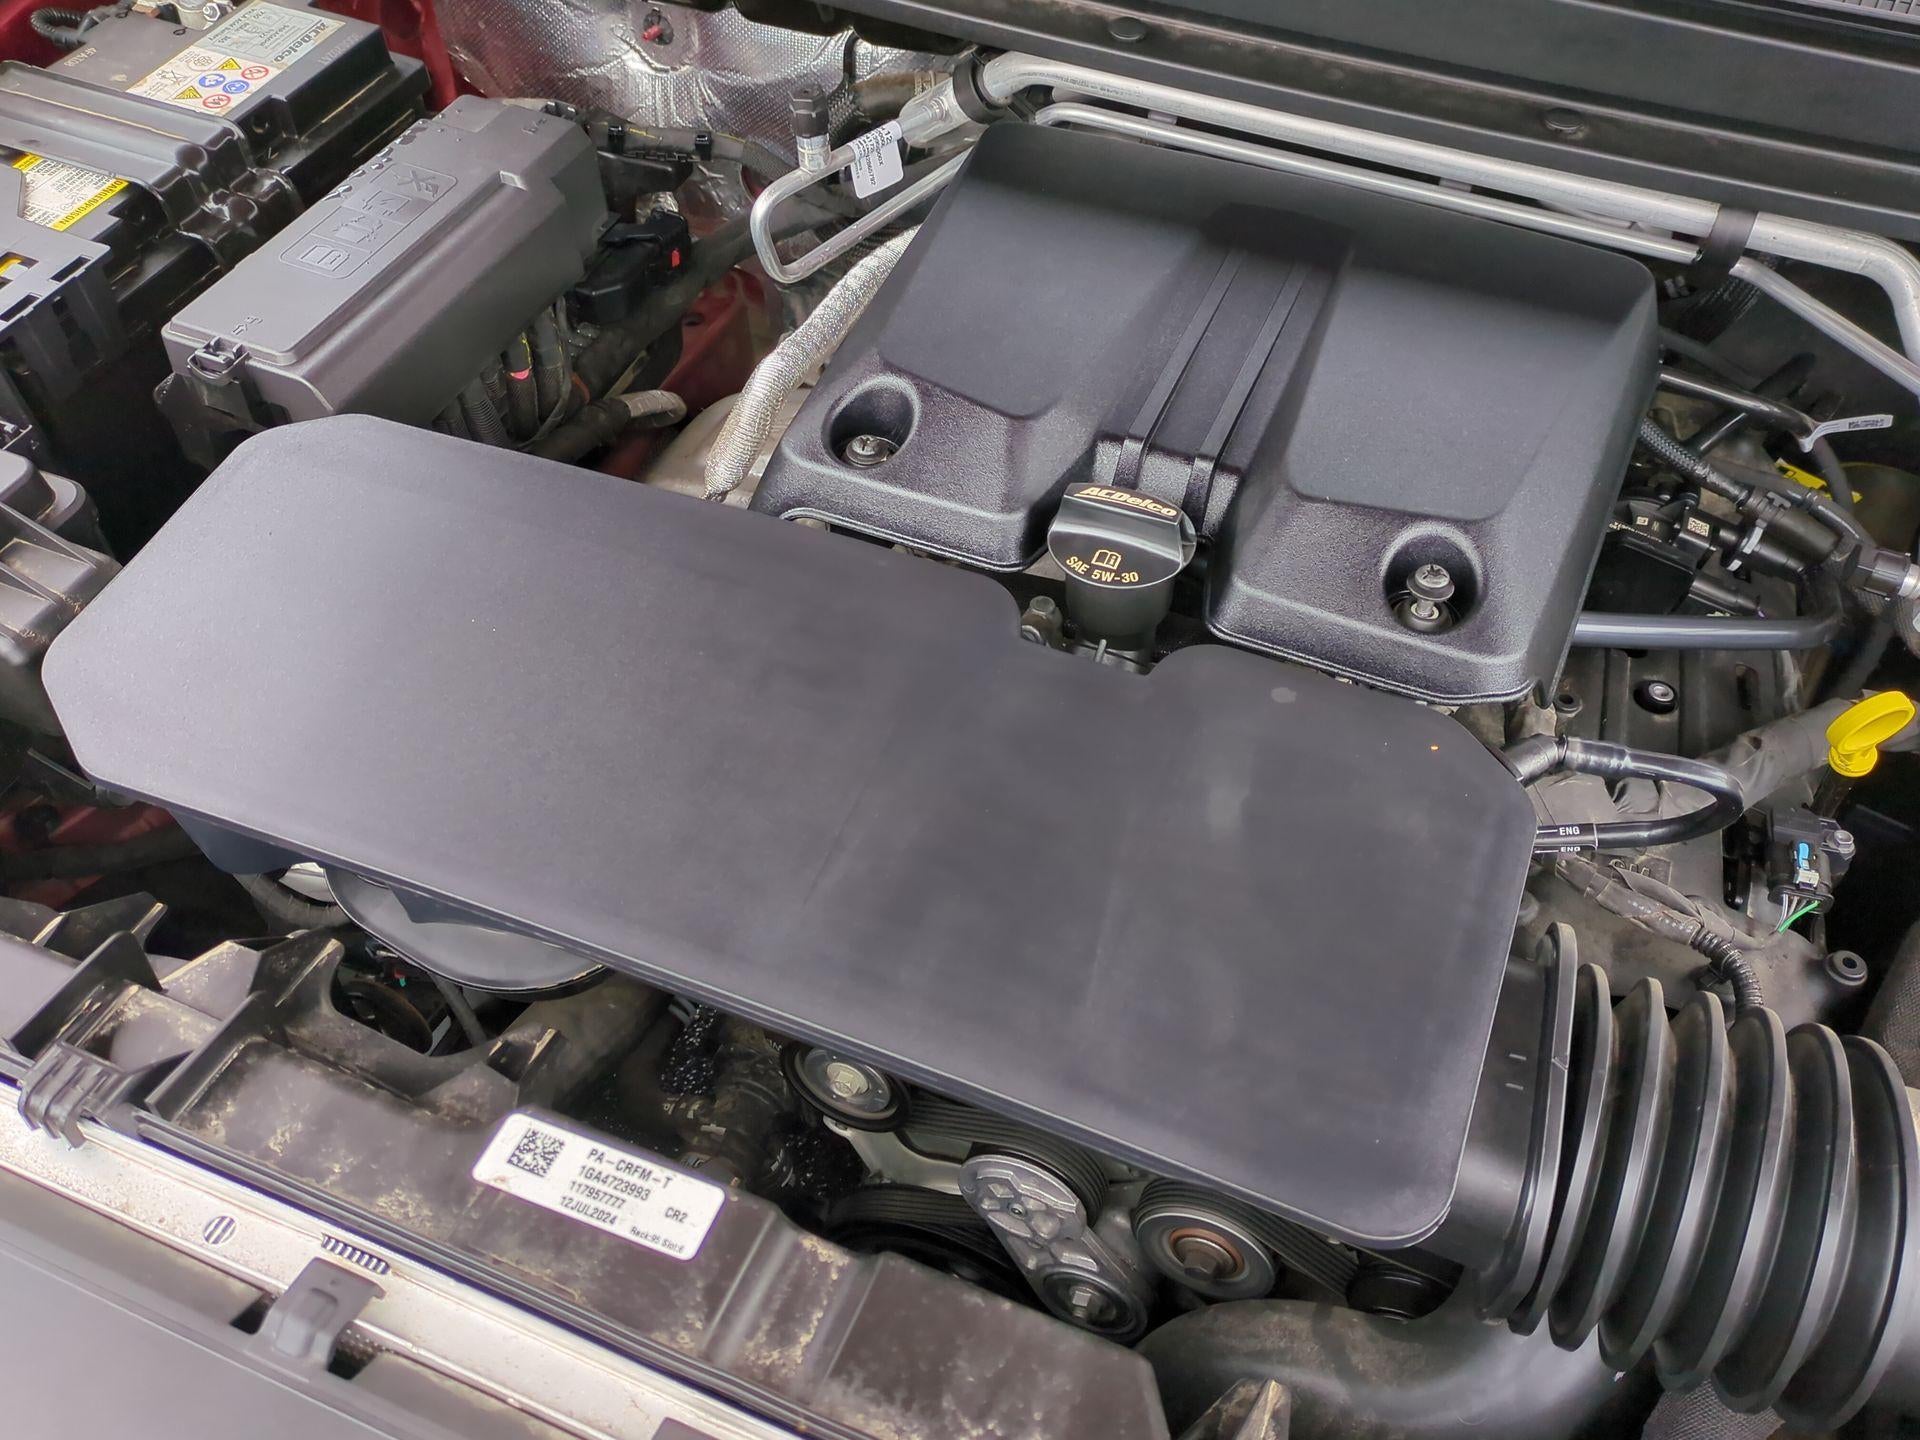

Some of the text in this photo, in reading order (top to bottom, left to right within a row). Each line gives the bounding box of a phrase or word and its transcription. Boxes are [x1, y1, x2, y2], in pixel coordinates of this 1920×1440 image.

[273, 22, 328, 63] ACDelco
[1078, 487, 1178, 518] ACDelco
[1066, 556, 1139, 583] SAE 5W-30
[1559, 826, 1580, 836] ENG
[569, 1180, 627, 1210] 117957777
[579, 1164, 651, 1202] 1GA4723993
[560, 1195, 618, 1226] 12JUL2024
[664, 1206, 689, 1224] CR2
